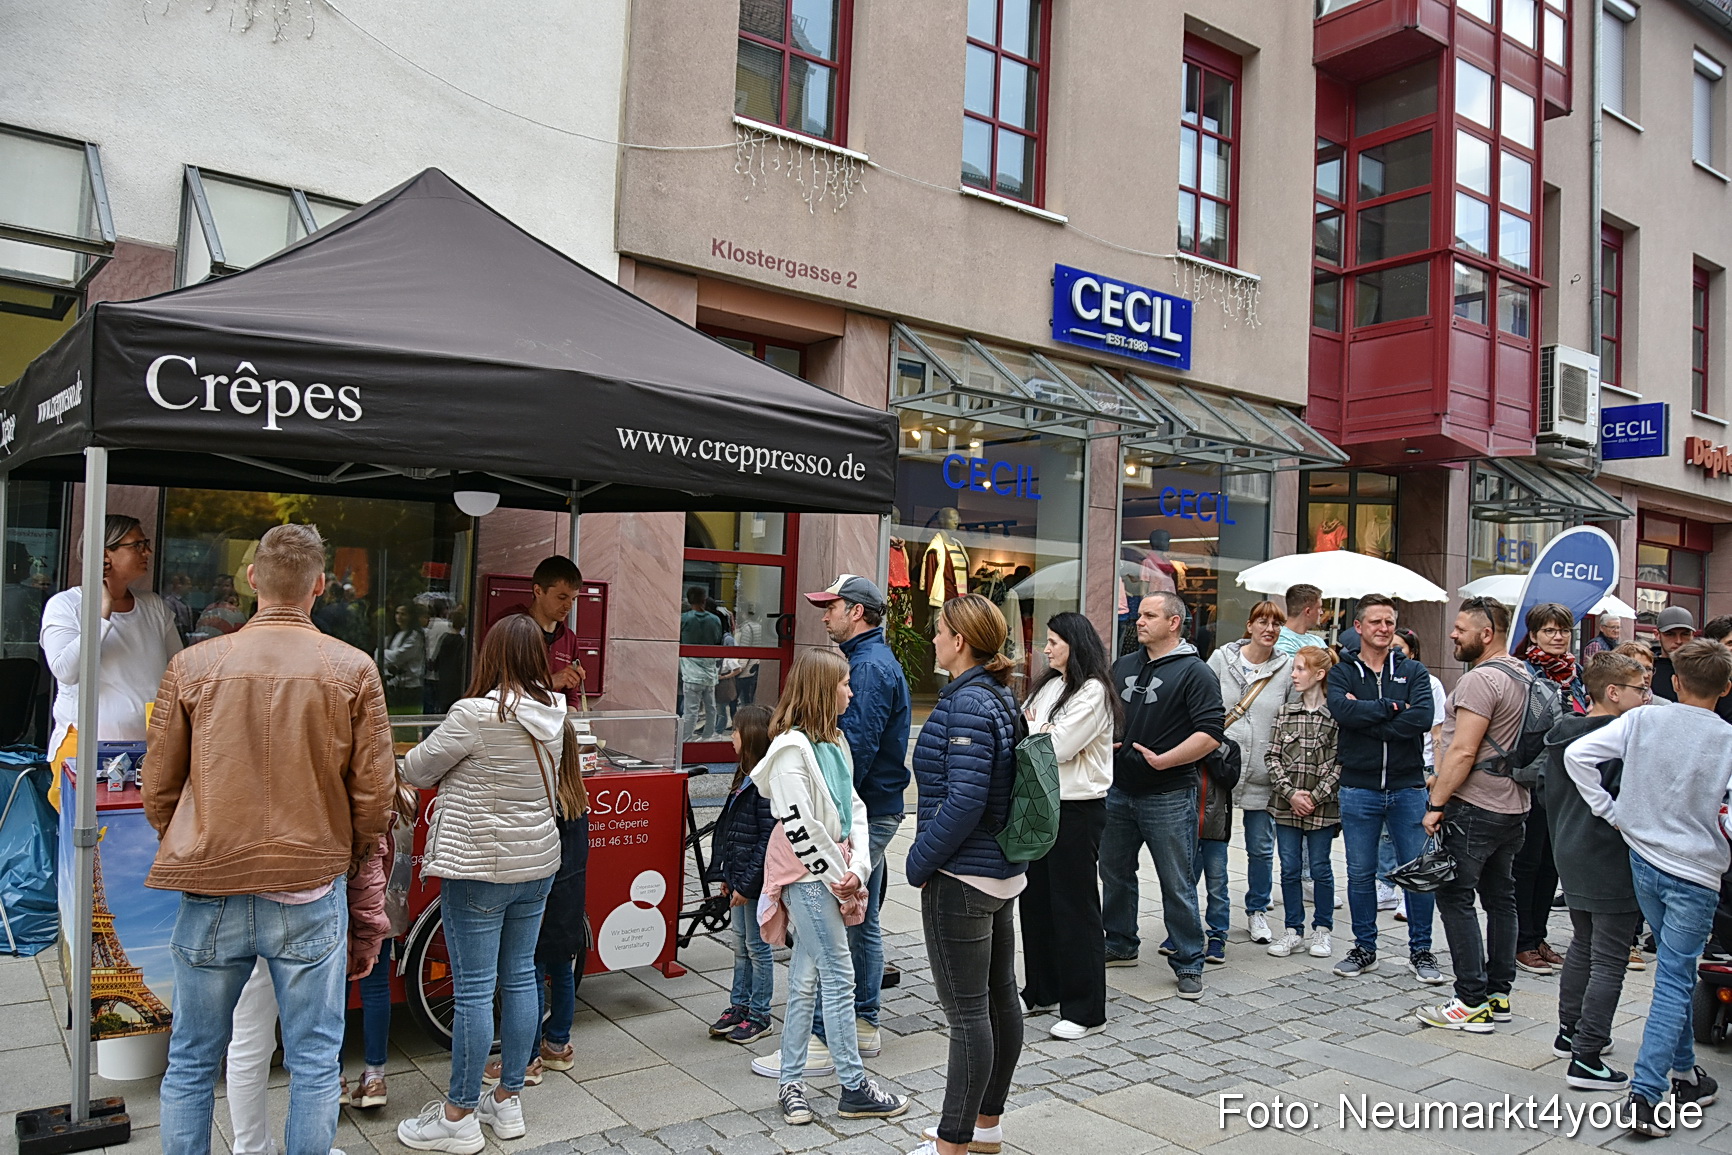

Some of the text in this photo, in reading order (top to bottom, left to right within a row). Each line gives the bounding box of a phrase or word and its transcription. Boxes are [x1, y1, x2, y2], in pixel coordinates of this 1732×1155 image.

[711, 238, 858, 289] Klostergasse 2
[1071, 276, 1183, 343] CECIL
[145, 354, 363, 431] Crêpes
[1602, 420, 1657, 438] CECIL
[616, 427, 866, 481] www.creppresso.de
[942, 453, 1043, 500] CECIL
[1159, 486, 1237, 525] CECIL
[1551, 561, 1604, 581] CECIL
[588, 818, 649, 831] bile Crêperie
[608, 835, 621, 846] 46
[623, 834, 634, 845] 31
[636, 833, 649, 844] 50
[781, 804, 829, 875] GIRL
